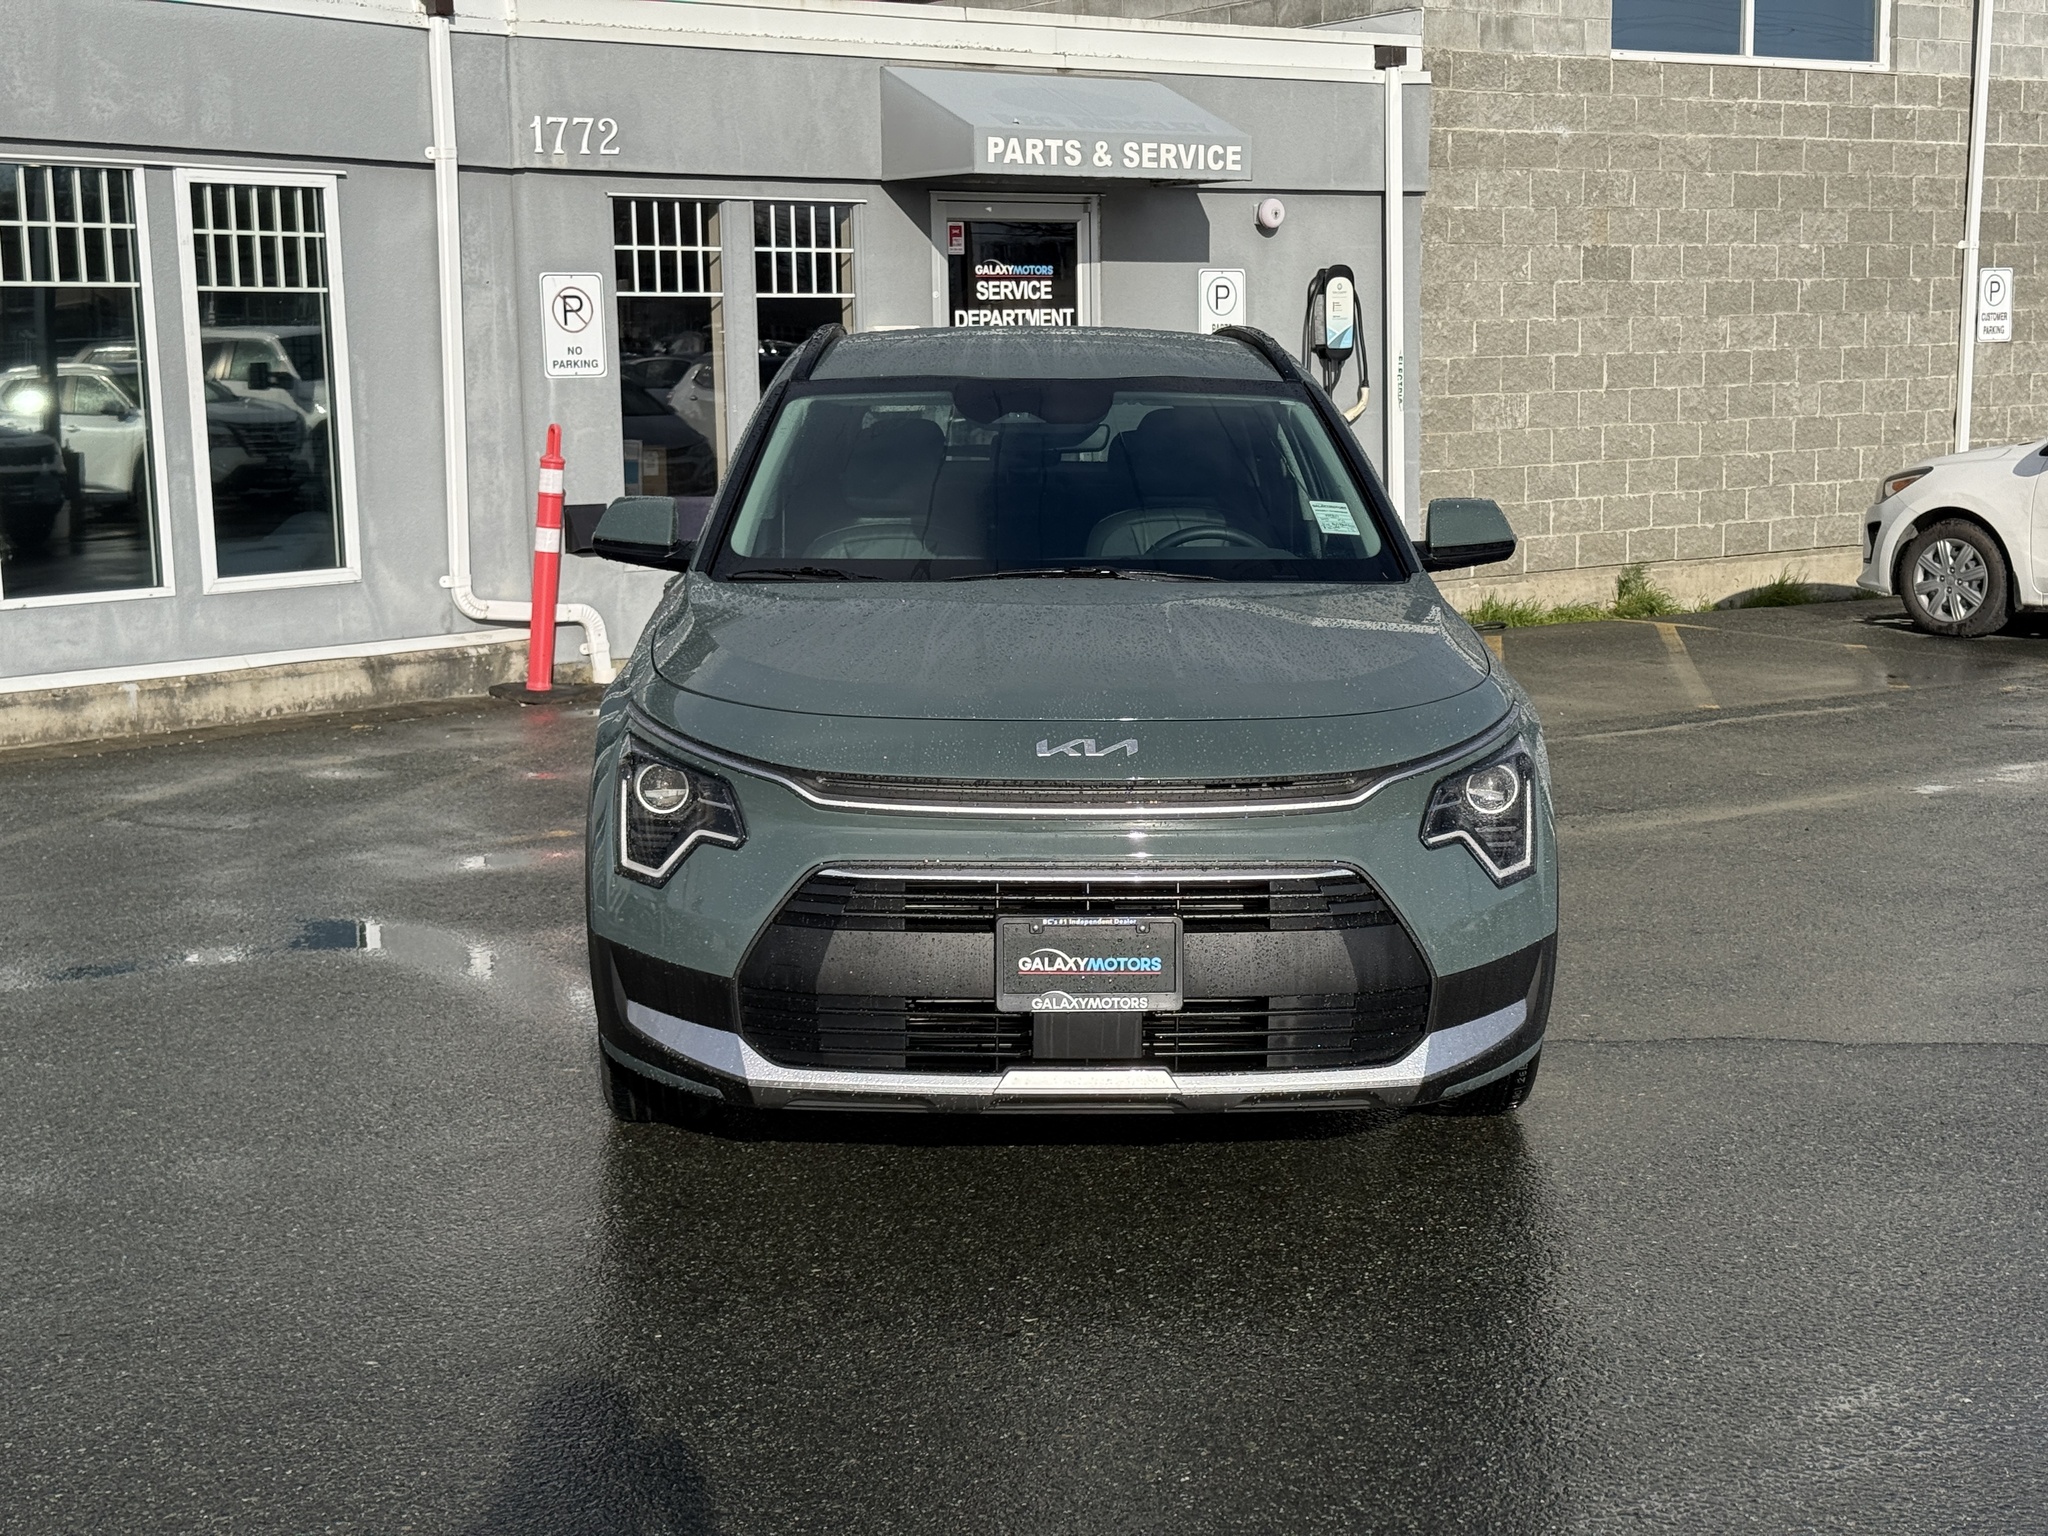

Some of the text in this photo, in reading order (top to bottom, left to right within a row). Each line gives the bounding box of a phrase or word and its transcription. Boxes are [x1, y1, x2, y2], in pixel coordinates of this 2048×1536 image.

[530, 115, 621, 156] 1772
[987, 136, 1243, 171] PARTS & SERVICE
[975, 264, 1054, 275] GALAXYMOTORS
[976, 280, 1053, 301] SERVICE
[1215, 284, 1230, 311] P
[1989, 280, 2001, 302] P
[562, 294, 584, 326] P
[954, 308, 1075, 328] DEPARTMENT
[1981, 312, 2008, 322] CUSTOMER
[1983, 325, 2005, 335] PARKING
[567, 345, 583, 356] NO
[552, 359, 599, 369] PARKING
[1069, 918, 1113, 926] Independent
[1113, 918, 1137, 926] Dealer
[1018, 956, 1162, 973] GALAXYMOTORS
[1031, 997, 1149, 1010] GALAXYMOTORS
